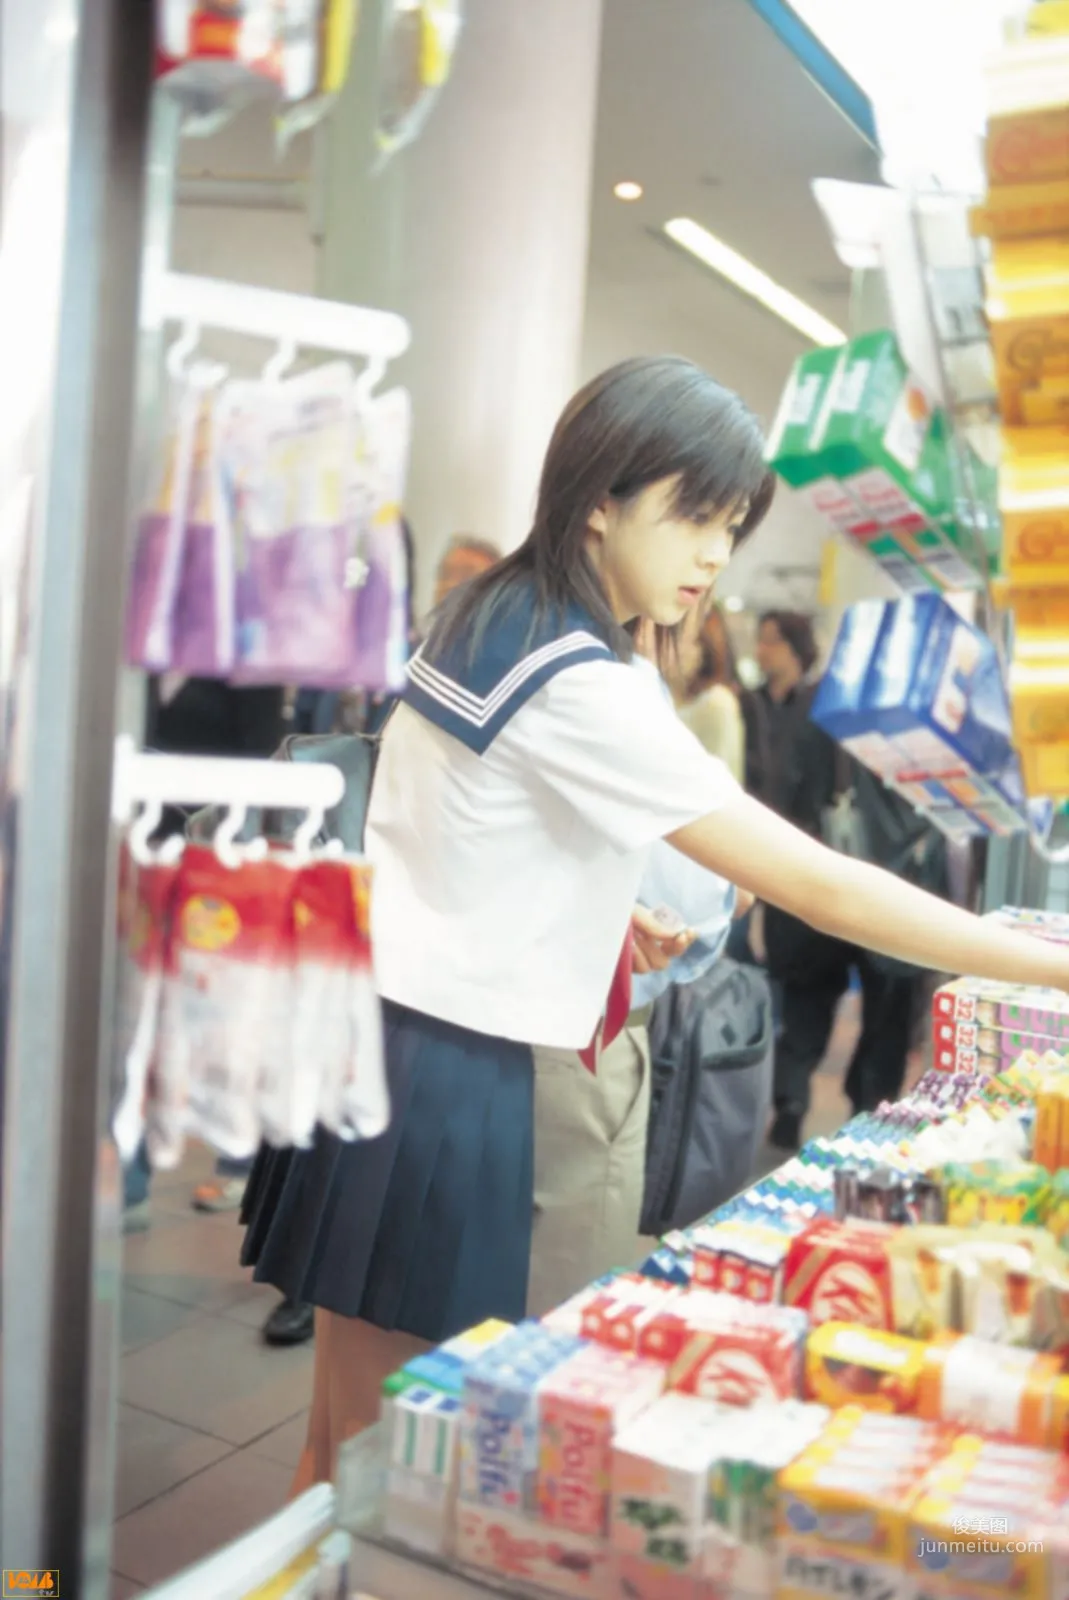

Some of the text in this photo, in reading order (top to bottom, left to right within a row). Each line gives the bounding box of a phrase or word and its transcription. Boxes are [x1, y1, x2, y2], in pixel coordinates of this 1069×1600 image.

[957, 997, 973, 1020] 32
[959, 1026, 975, 1048] 32
[959, 1052, 975, 1074] 32
